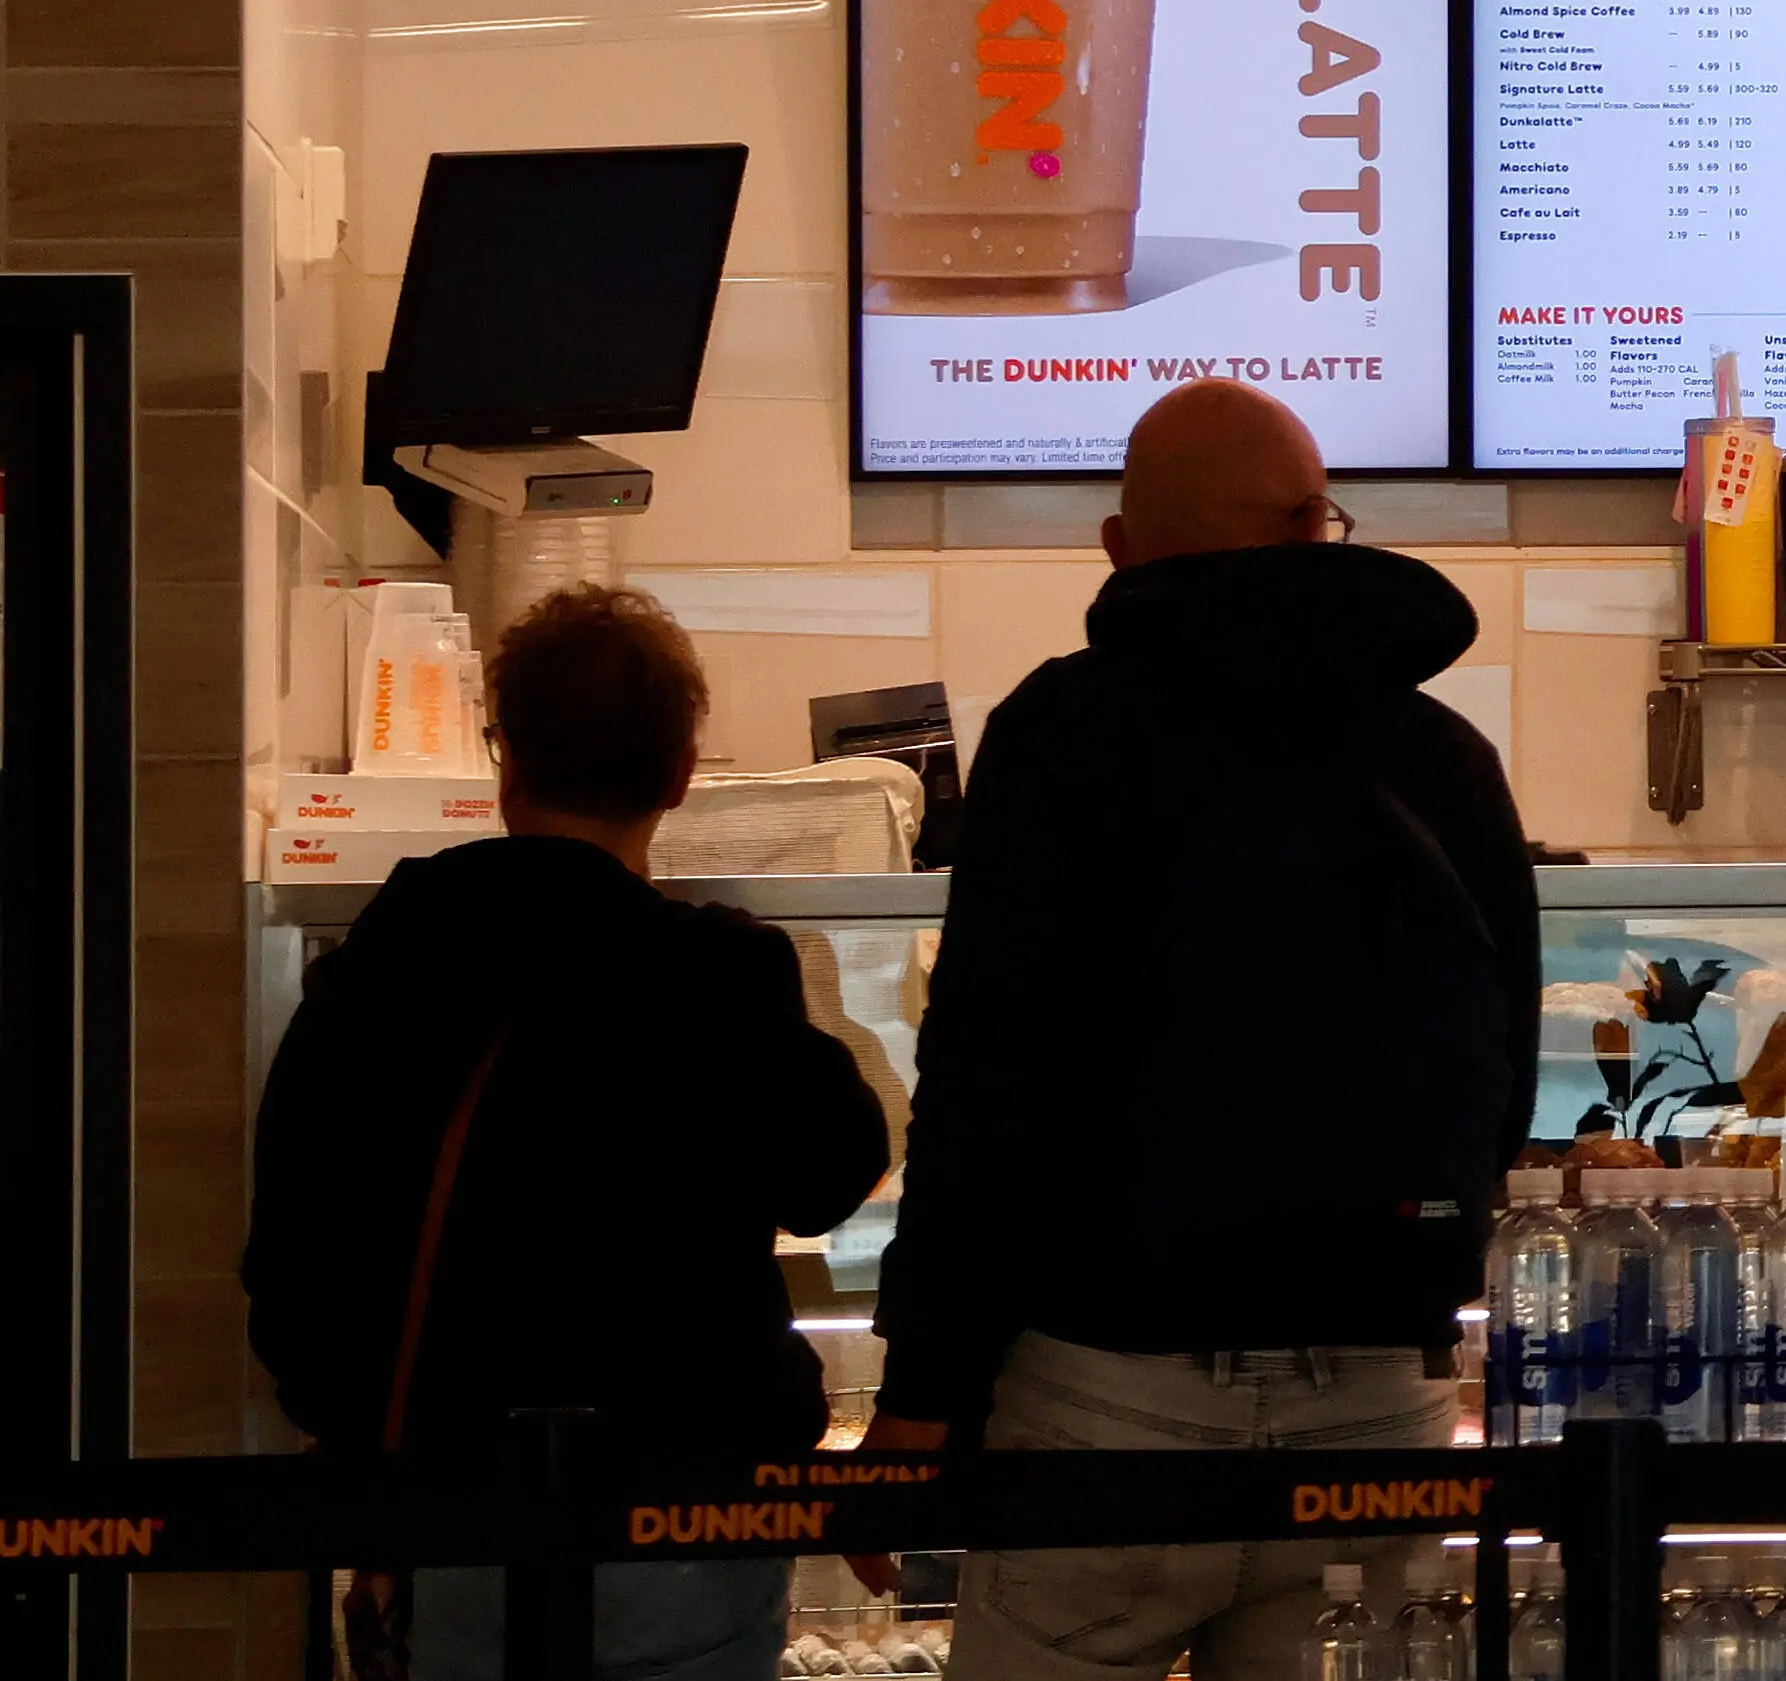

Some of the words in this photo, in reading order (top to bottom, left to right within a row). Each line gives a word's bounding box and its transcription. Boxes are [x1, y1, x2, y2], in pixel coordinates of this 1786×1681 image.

[1500, 7, 1550, 17] Almond
[1553, 7, 1588, 19] Spice
[1592, 7, 1636, 17] Coffee
[1500, 30, 1530, 40] Cold
[1534, 30, 1566, 40] Brew
[1500, 163, 1570, 174] Macchiato
[1500, 231, 1557, 244] Espresso
[1499, 307, 1567, 326] MAKE
[1574, 307, 1597, 326] IT
[1603, 307, 1684, 326] YOURS
[930, 359, 993, 382] THE
[1003, 359, 1138, 382] DUNKIN'
[1147, 358, 1217, 380] WAY
[1227, 358, 1271, 381] TO
[1281, 357, 1382, 381] LATTE
[1292, 1477, 1493, 1522] DUNKIN'
[630, 1502, 835, 1543] DUNKIN'
